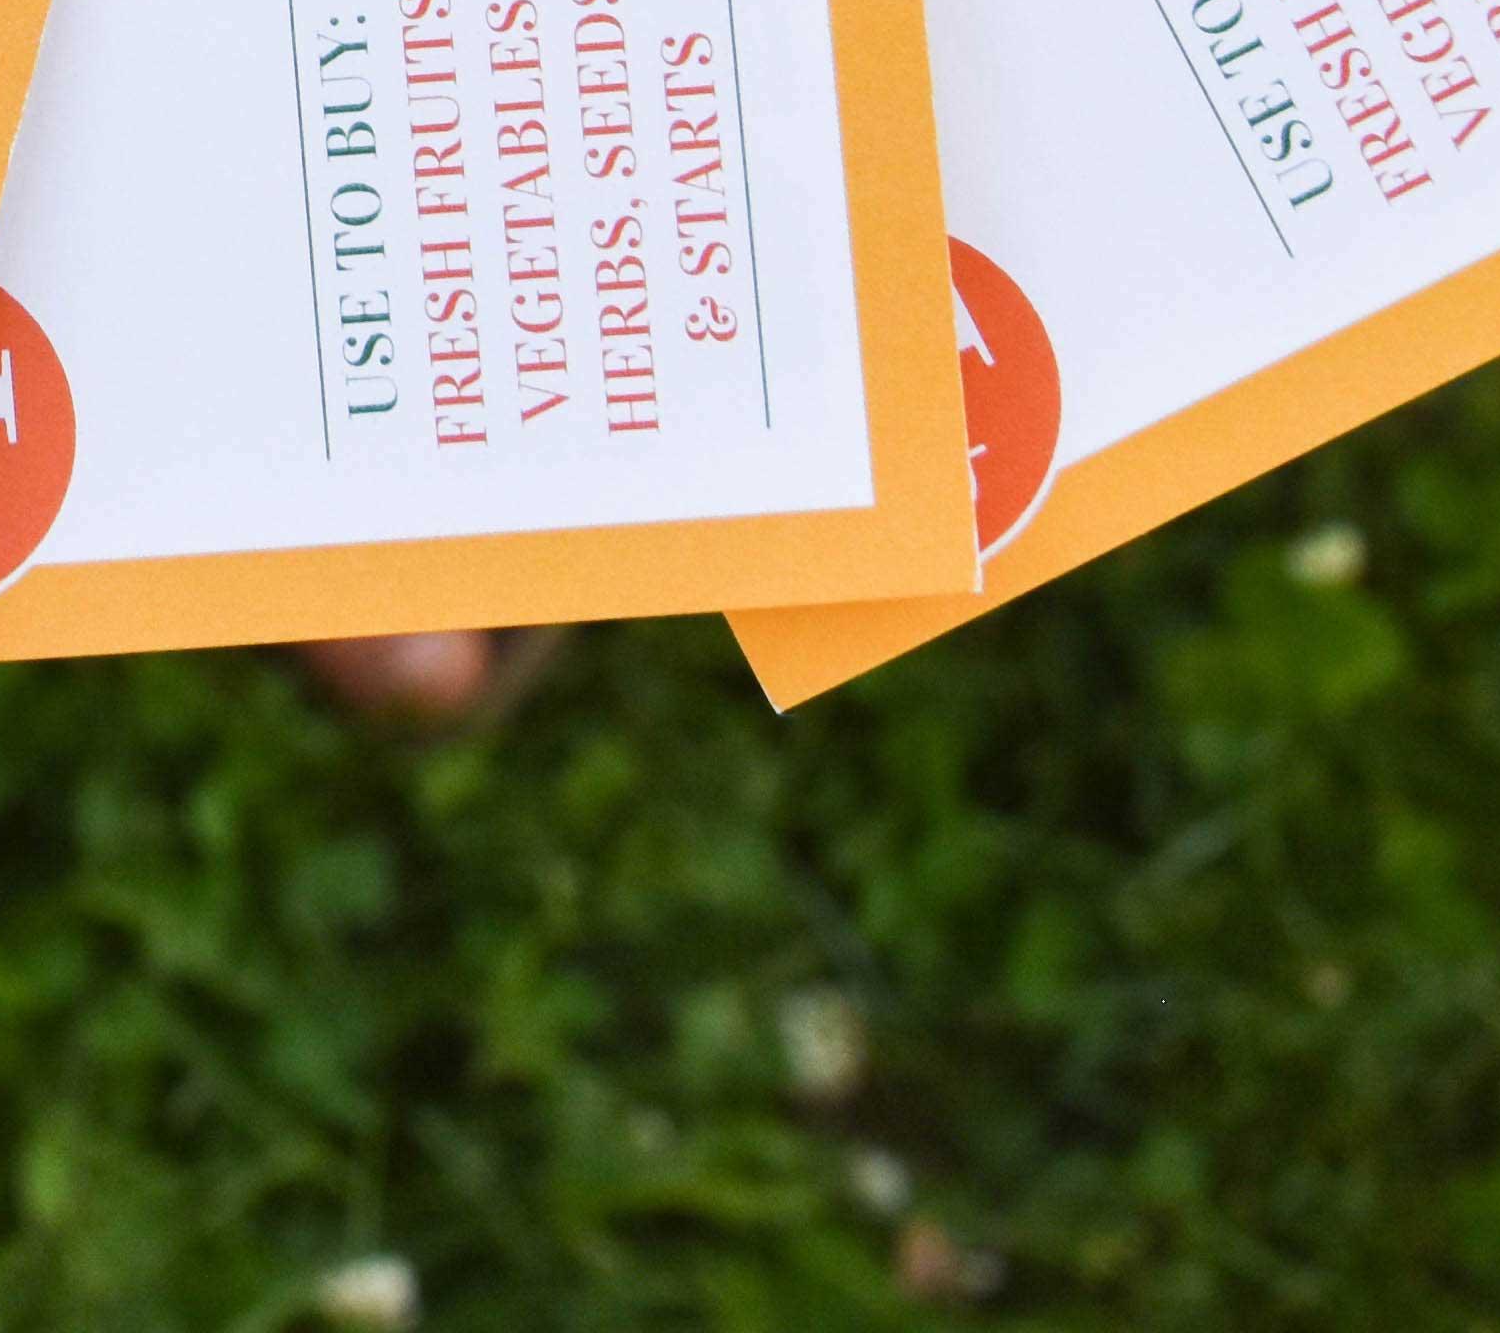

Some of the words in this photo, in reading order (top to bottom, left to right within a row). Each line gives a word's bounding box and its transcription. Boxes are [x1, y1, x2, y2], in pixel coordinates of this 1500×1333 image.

[319, 14, 377, 160] BUY:
[662, 32, 731, 276] STARTS
[1238, 78, 1334, 209] USE
[1292, 1, 1433, 202] FRESH
[330, 182, 386, 272] TO
[338, 289, 398, 419] USE
[420, 236, 488, 449] FRESH
[591, 198, 660, 433] HERBS,
[685, 296, 738, 342] &
